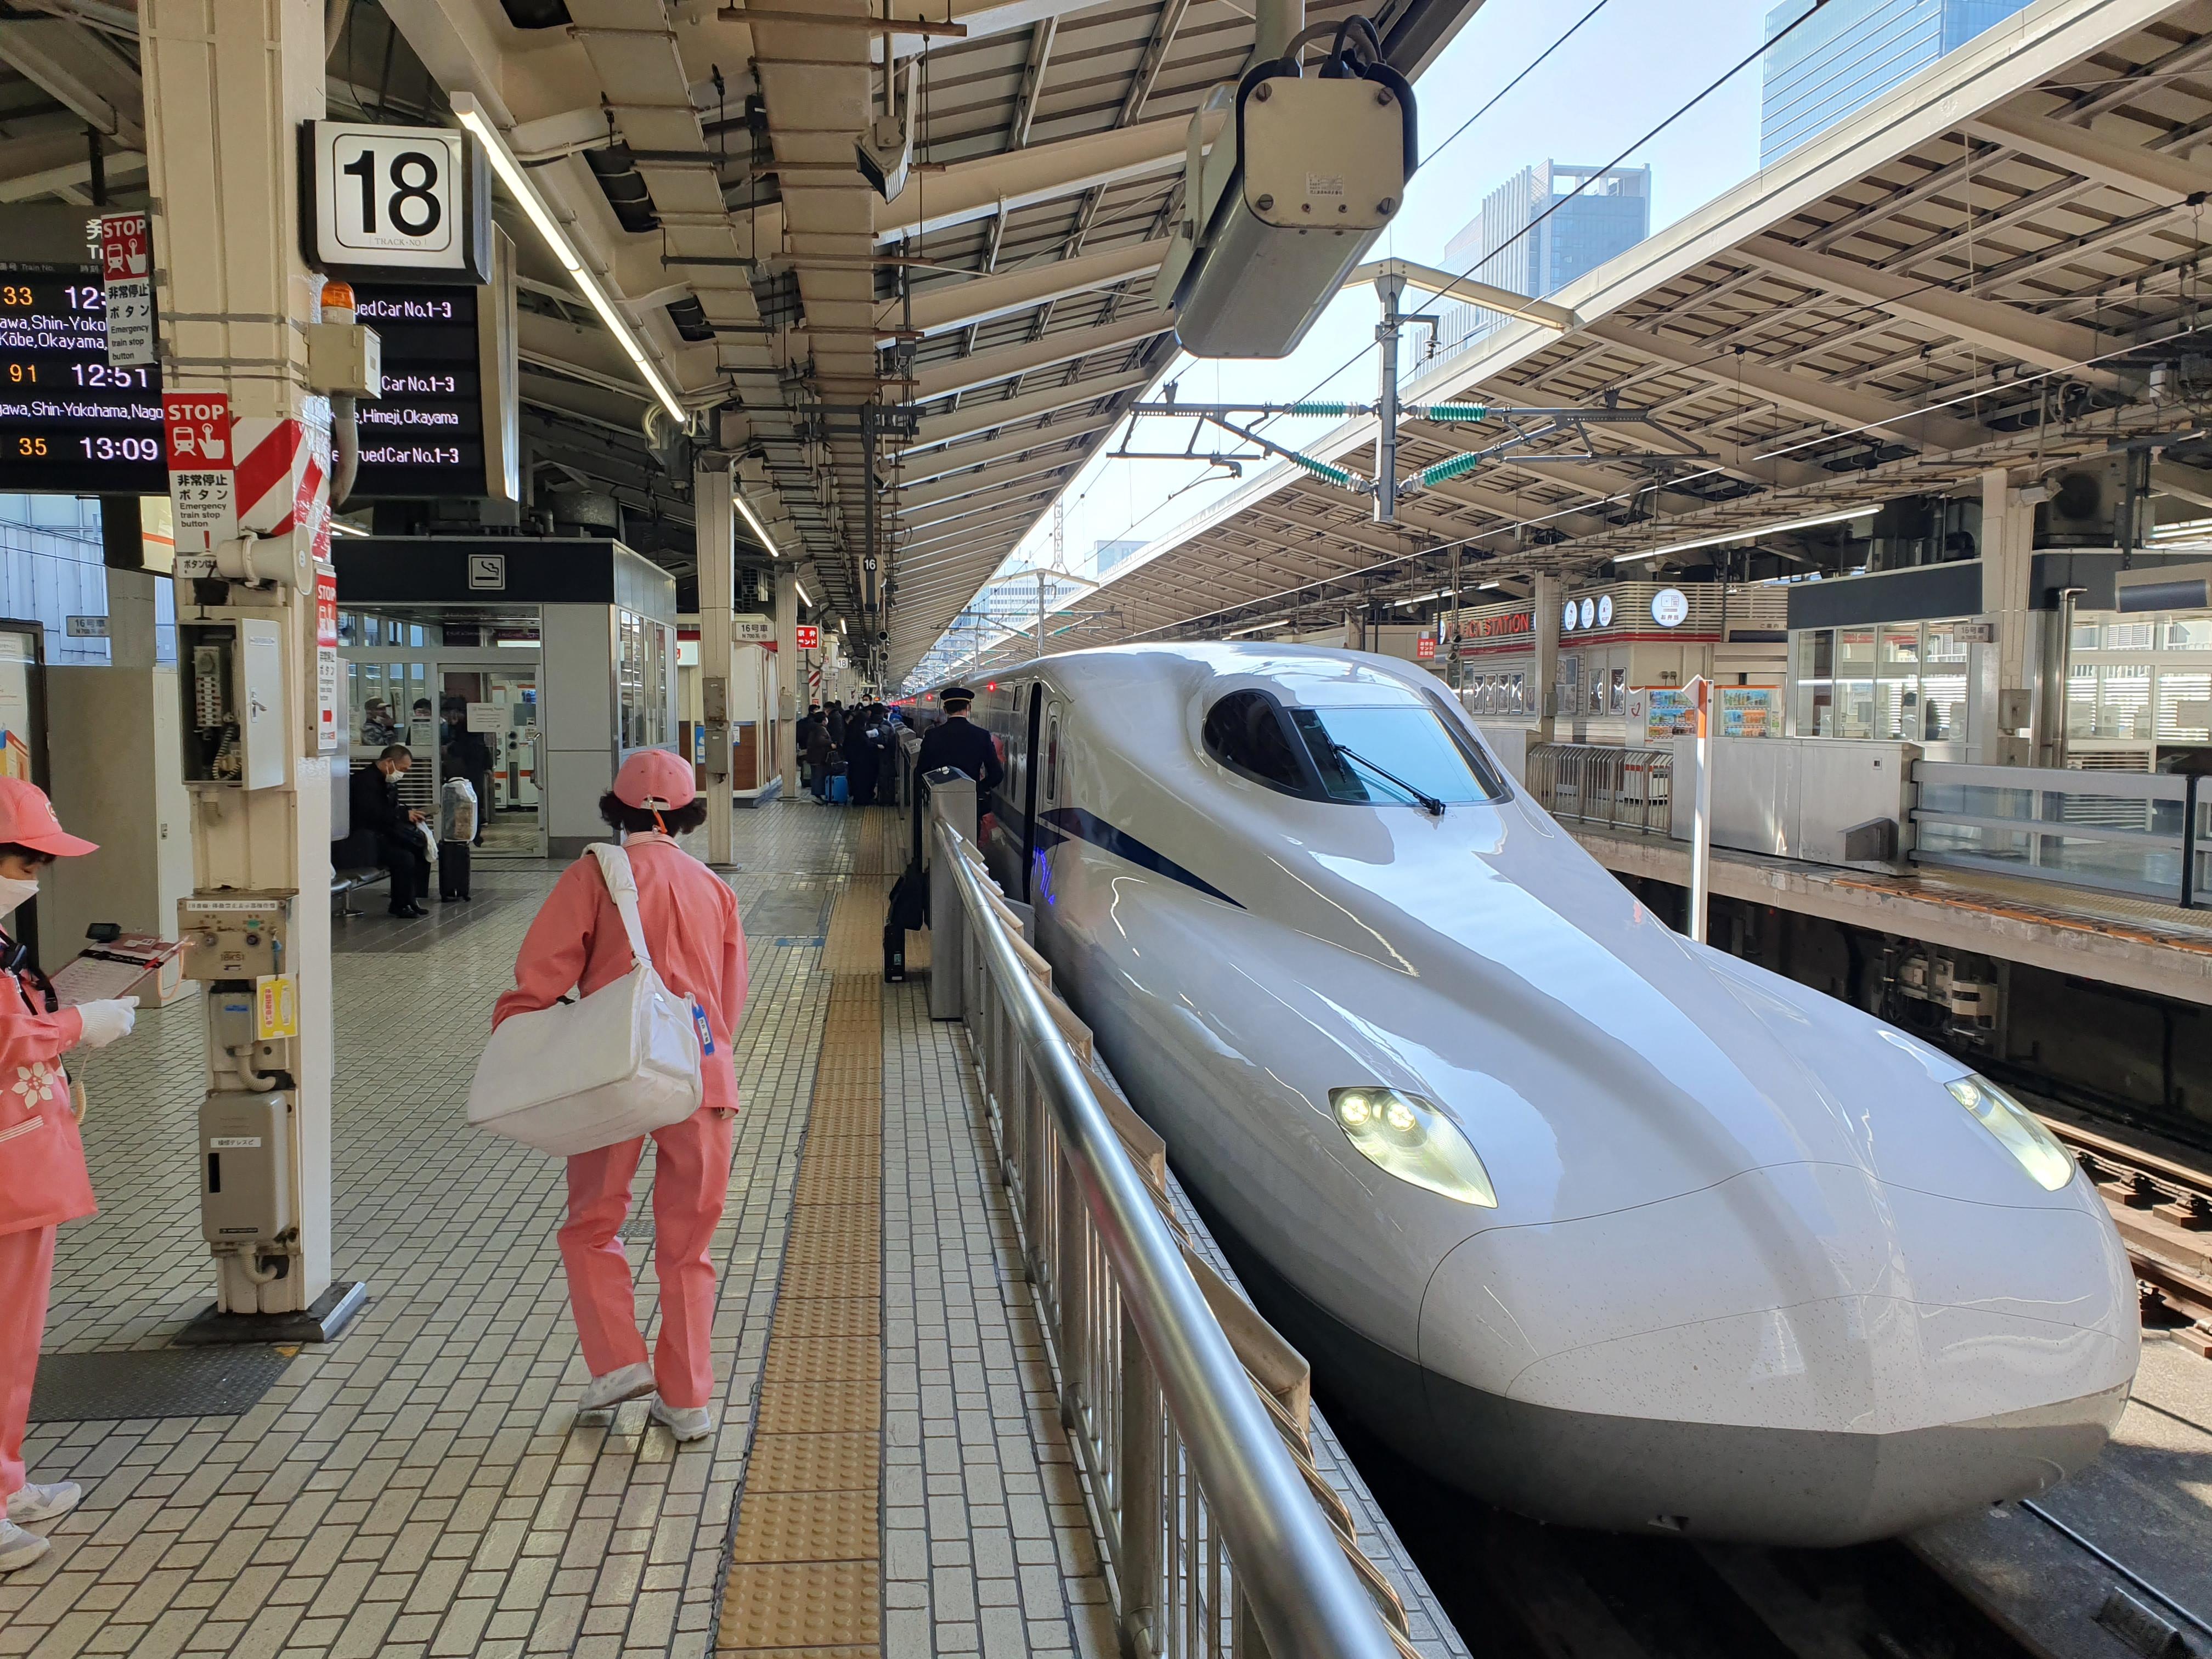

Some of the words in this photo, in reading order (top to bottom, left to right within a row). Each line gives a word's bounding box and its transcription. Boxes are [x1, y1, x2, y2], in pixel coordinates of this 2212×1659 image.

[344, 150, 441, 237] 18
[103, 219, 146, 238] STOP
[3, 286, 33, 305] 33
[109, 283, 149, 300] 非常停止
[110, 304, 150, 319] ボタン
[378, 300, 402, 317] Car
[111, 325, 149, 335] Emergency
[112, 338, 127, 347] train
[129, 337, 144, 347] stop
[112, 352, 135, 360] button
[9, 364, 37, 382] 91
[71, 363, 148, 388] 12:51
[381, 375, 405, 392] Car
[168, 404, 224, 421] STOP
[19, 437, 48, 456] 35
[80, 437, 159, 461] 13:09
[387, 447, 411, 463] Car
[177, 473, 228, 487] 非常停止
[179, 489, 228, 501] ボタン
[180, 502, 227, 512] Emergency
[202, 512, 221, 520] stop
[864, 558, 876, 570] 16
[318, 584, 336, 602] STOP
[741, 624, 768, 633] 16号車
